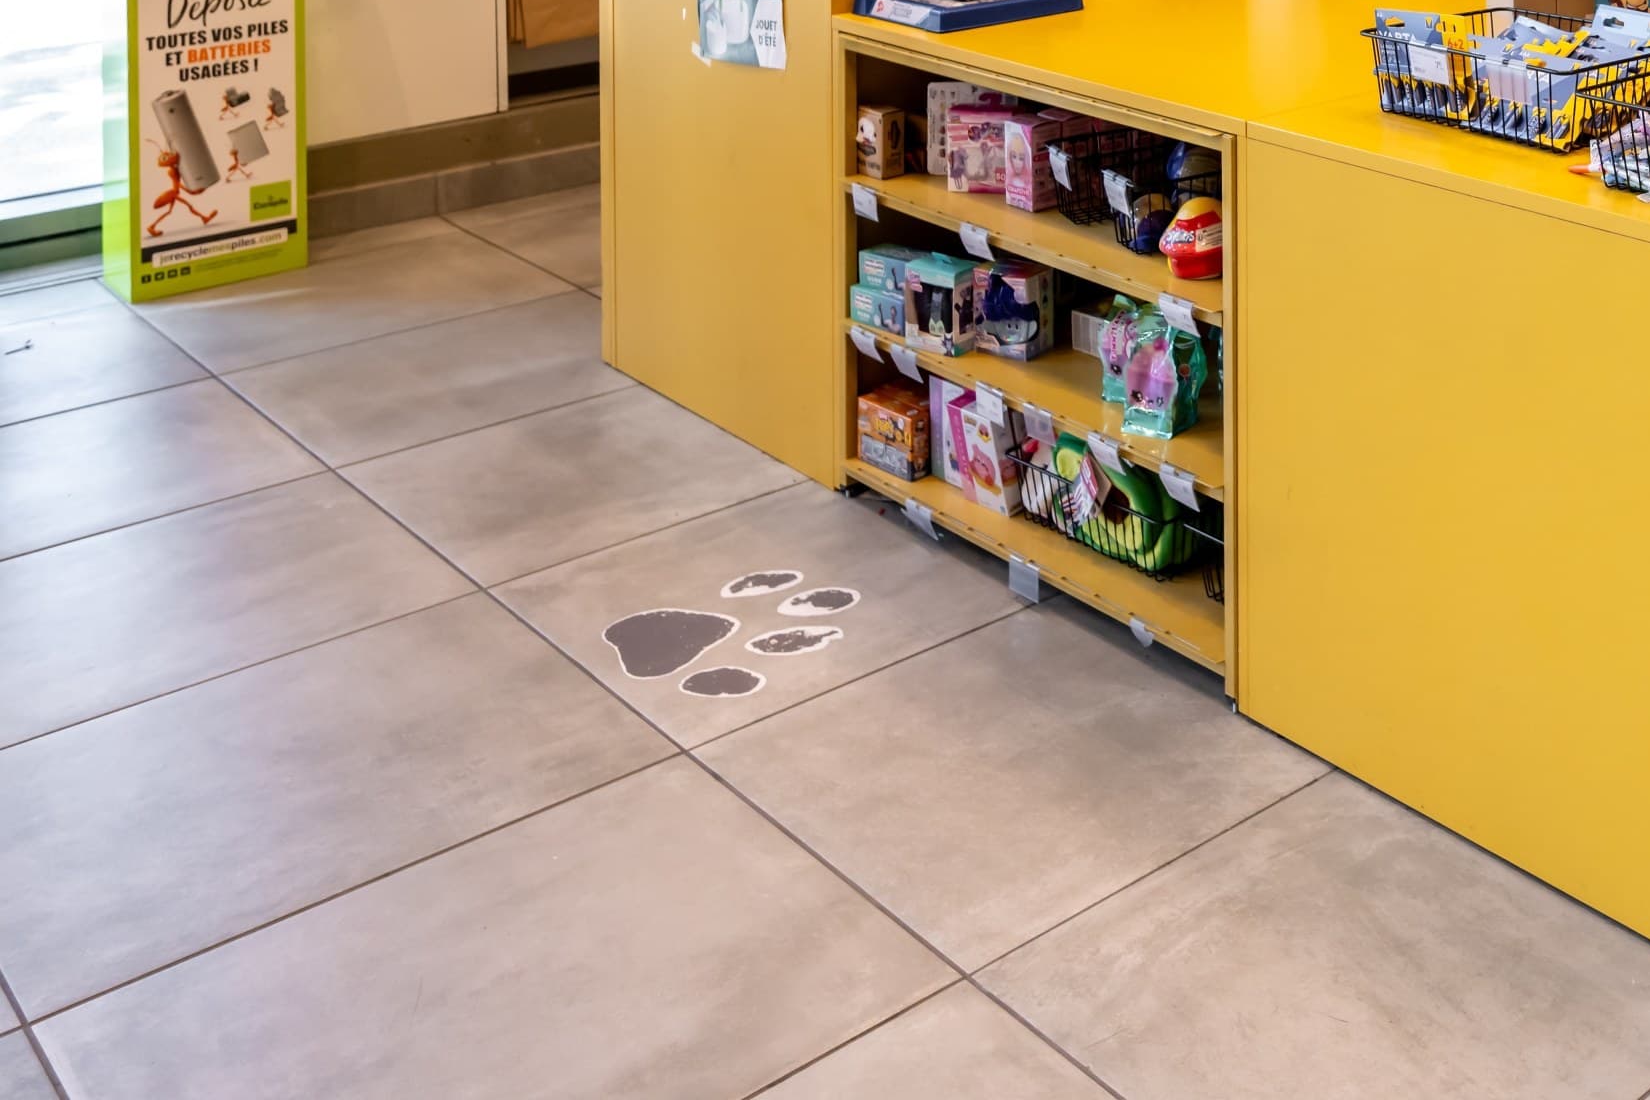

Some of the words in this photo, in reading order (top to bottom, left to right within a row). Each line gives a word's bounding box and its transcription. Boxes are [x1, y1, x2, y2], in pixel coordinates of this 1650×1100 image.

[146, 30, 207, 52] TOUTES
[211, 26, 243, 42] VOS
[247, 19, 289, 38] PILES
[755, 20, 778, 33] JOUET
[758, 33, 777, 48] D'ÉTÉ
[165, 51, 183, 66] ET
[187, 39, 271, 63] BATTERIES
[179, 59, 249, 82] USAGÉES
